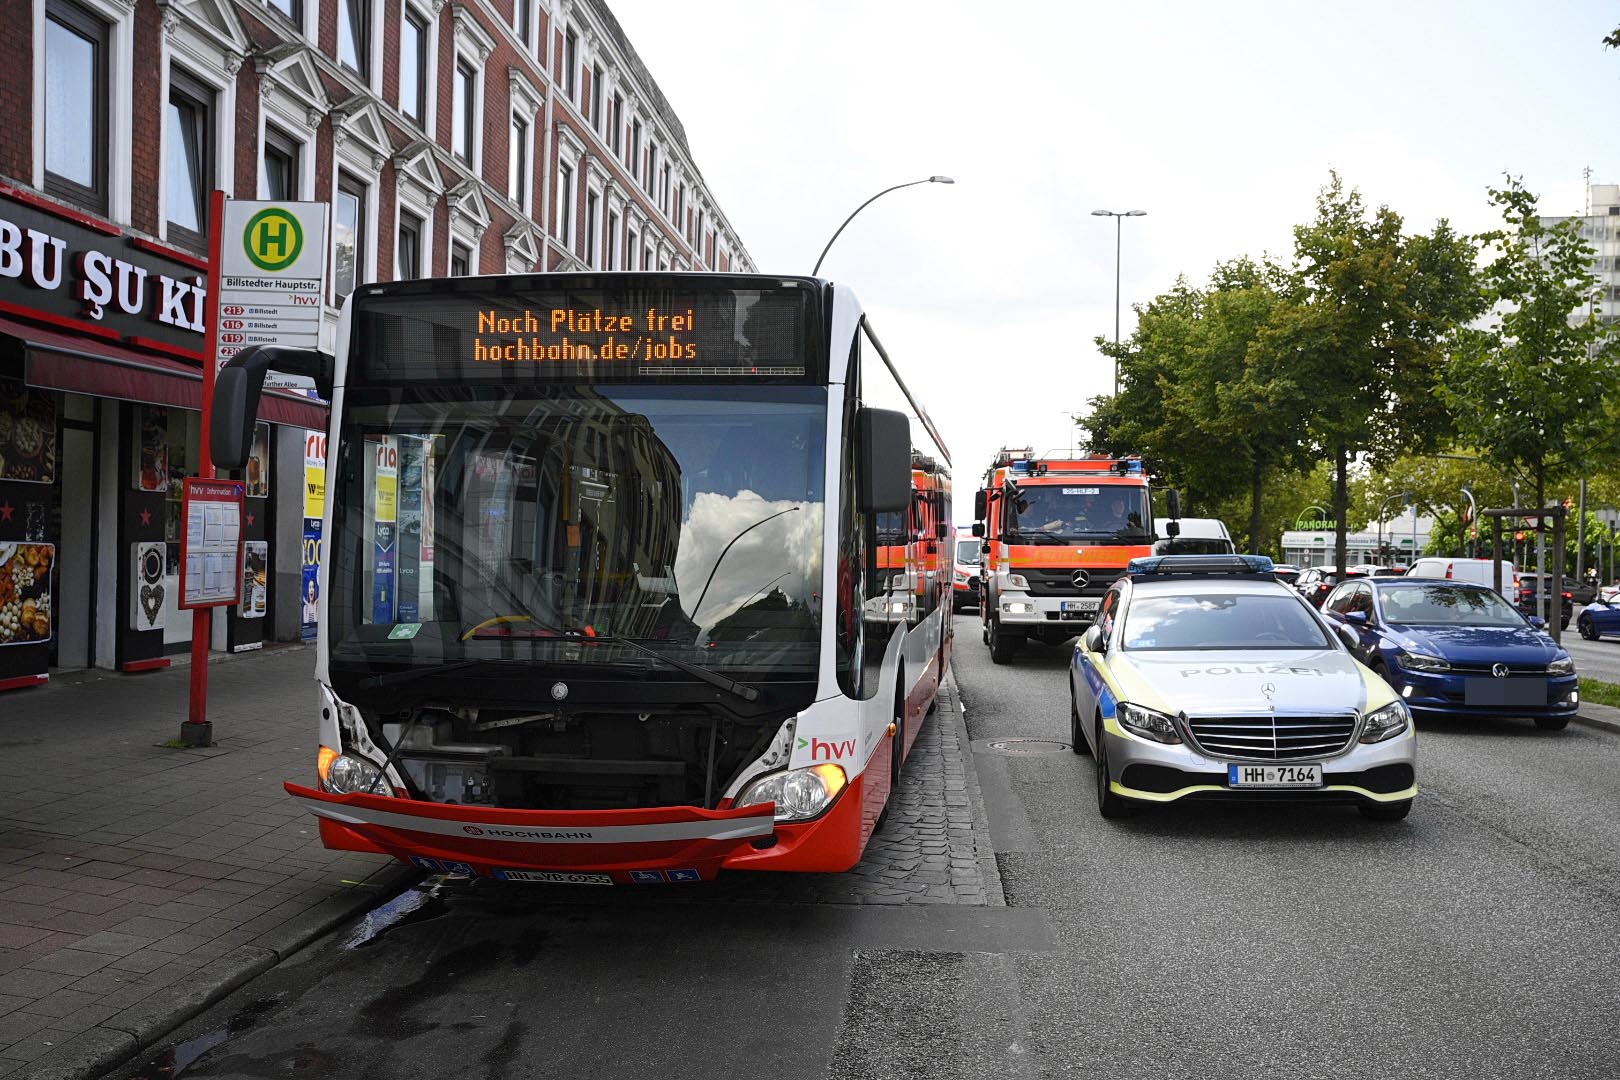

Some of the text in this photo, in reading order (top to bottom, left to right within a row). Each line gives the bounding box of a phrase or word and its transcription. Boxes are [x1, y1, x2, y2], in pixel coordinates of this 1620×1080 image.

[259, 223, 287, 256] H
[84, 251, 147, 320] ŞU
[227, 278, 317, 290] Billstedter Hauptstr.
[294, 294, 318, 305] hvv
[226, 307, 242, 315] 213
[225, 320, 241, 329] 116
[478, 308, 694, 333] Noch Plätze frei
[225, 334, 241, 343] 119
[474, 335, 697, 361] hochbahn.de/jobs
[190, 485, 231, 496] hvv Information
[1179, 666, 1324, 678] POLIZEI
[811, 737, 857, 761] hvv
[1244, 768, 1315, 782] HH 7164
[488, 828, 593, 840] HOCHBAHN
[506, 871, 531, 881] HH
